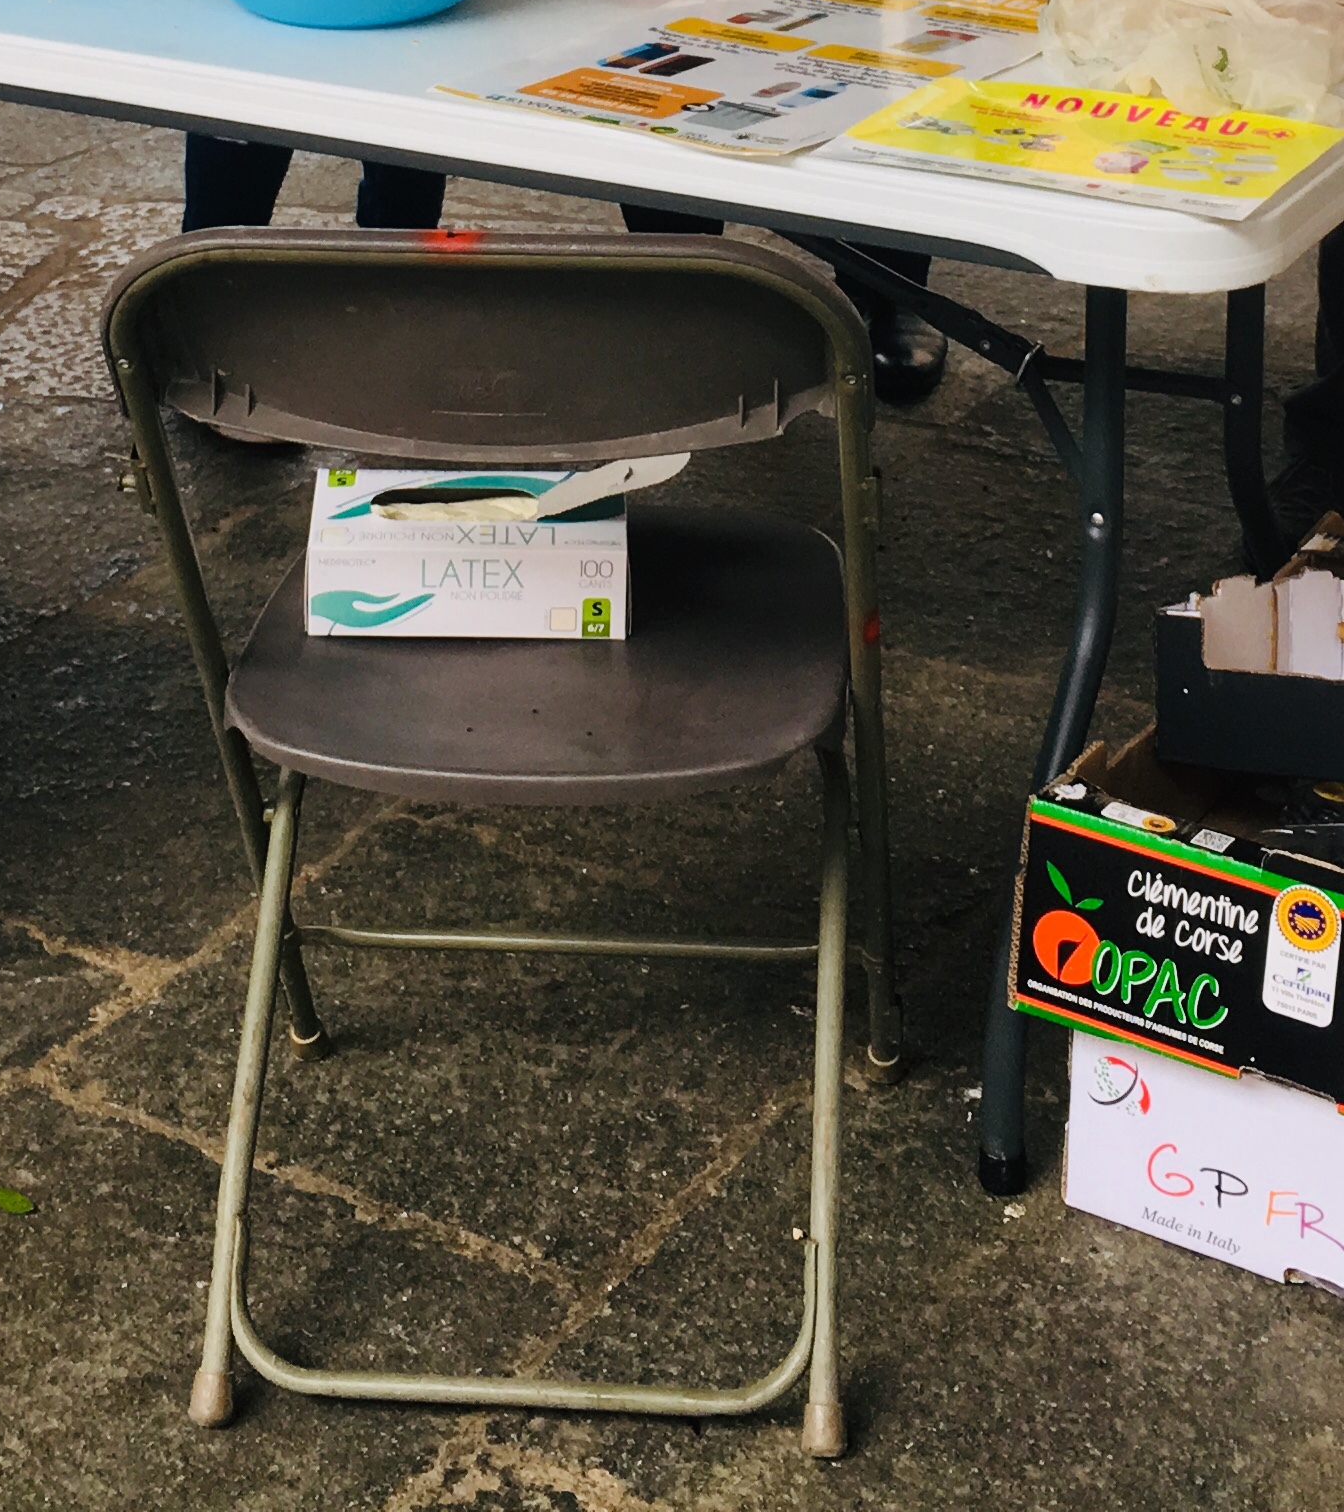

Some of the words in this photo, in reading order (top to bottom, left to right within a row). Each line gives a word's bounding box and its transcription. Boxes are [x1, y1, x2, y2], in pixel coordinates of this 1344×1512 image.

[1020, 92, 1251, 136] NOUVEAU
[457, 523, 556, 546] LATEX
[421, 558, 525, 589] LATEX
[450, 590, 478, 601] NON
[479, 590, 524, 602] POUDRE
[592, 601, 603, 617] S
[1127, 869, 1260, 935] Clémentine
[1135, 906, 1166, 940] de
[1174, 920, 1244, 964] Corse
[1091, 939, 1229, 1030] OPAC
[1272, 973, 1331, 1003] Certipaq
[1026, 978, 1078, 1004] ORGANISATION
[1077, 994, 1093, 1010] DES
[1093, 1000, 1145, 1028] PRODUCTEURS
[1145, 1018, 1187, 1042] D'AGRUMES
[1188, 1030, 1199, 1046] DE
[1199, 1035, 1225, 1055] CORSE
[1141, 1204, 1184, 1235] Made
[1186, 1224, 1203, 1241] in
[1205, 1228, 1243, 1256] Italy
